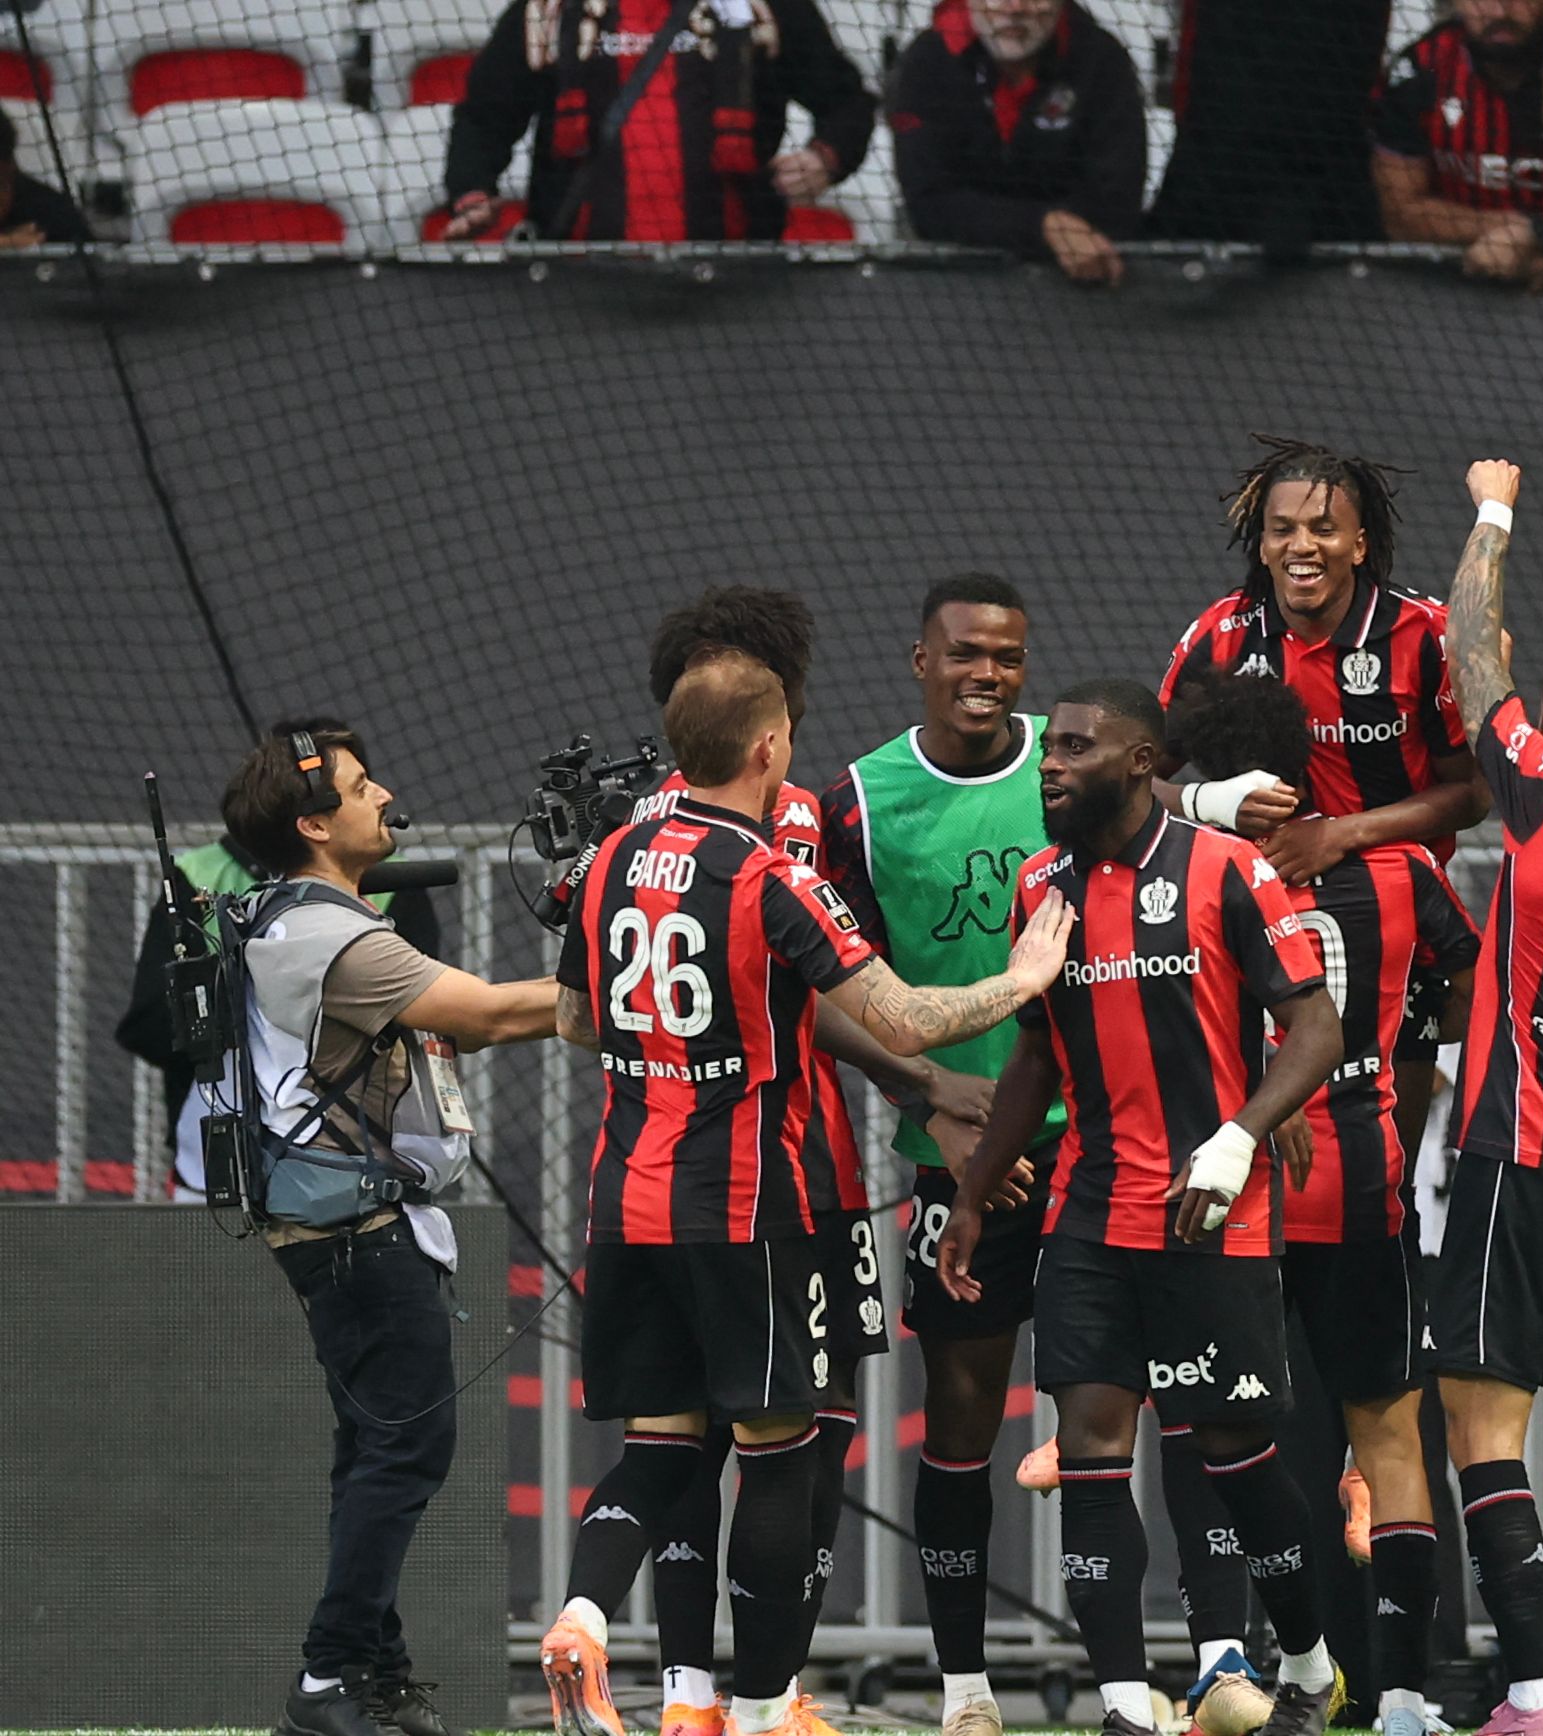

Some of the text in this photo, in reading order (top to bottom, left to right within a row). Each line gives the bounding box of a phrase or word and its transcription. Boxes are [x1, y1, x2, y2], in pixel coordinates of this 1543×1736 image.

[1313, 711, 1408, 744] inhood
[630, 788, 689, 825] OPPO
[564, 843, 600, 888] RONIN
[626, 849, 697, 894] BARD
[609, 906, 713, 1038] 26
[1064, 947, 1201, 987] Robinhood
[600, 1051, 743, 1082] GRENADIER
[1326, 1056, 1381, 1083] IER
[905, 1195, 951, 1268] 28
[851, 1220, 878, 1286] 3
[808, 1272, 827, 1339] 2
[1147, 1354, 1216, 1390] bet
[920, 1547, 976, 1563] OGC
[925, 1561, 977, 1578] NICE
